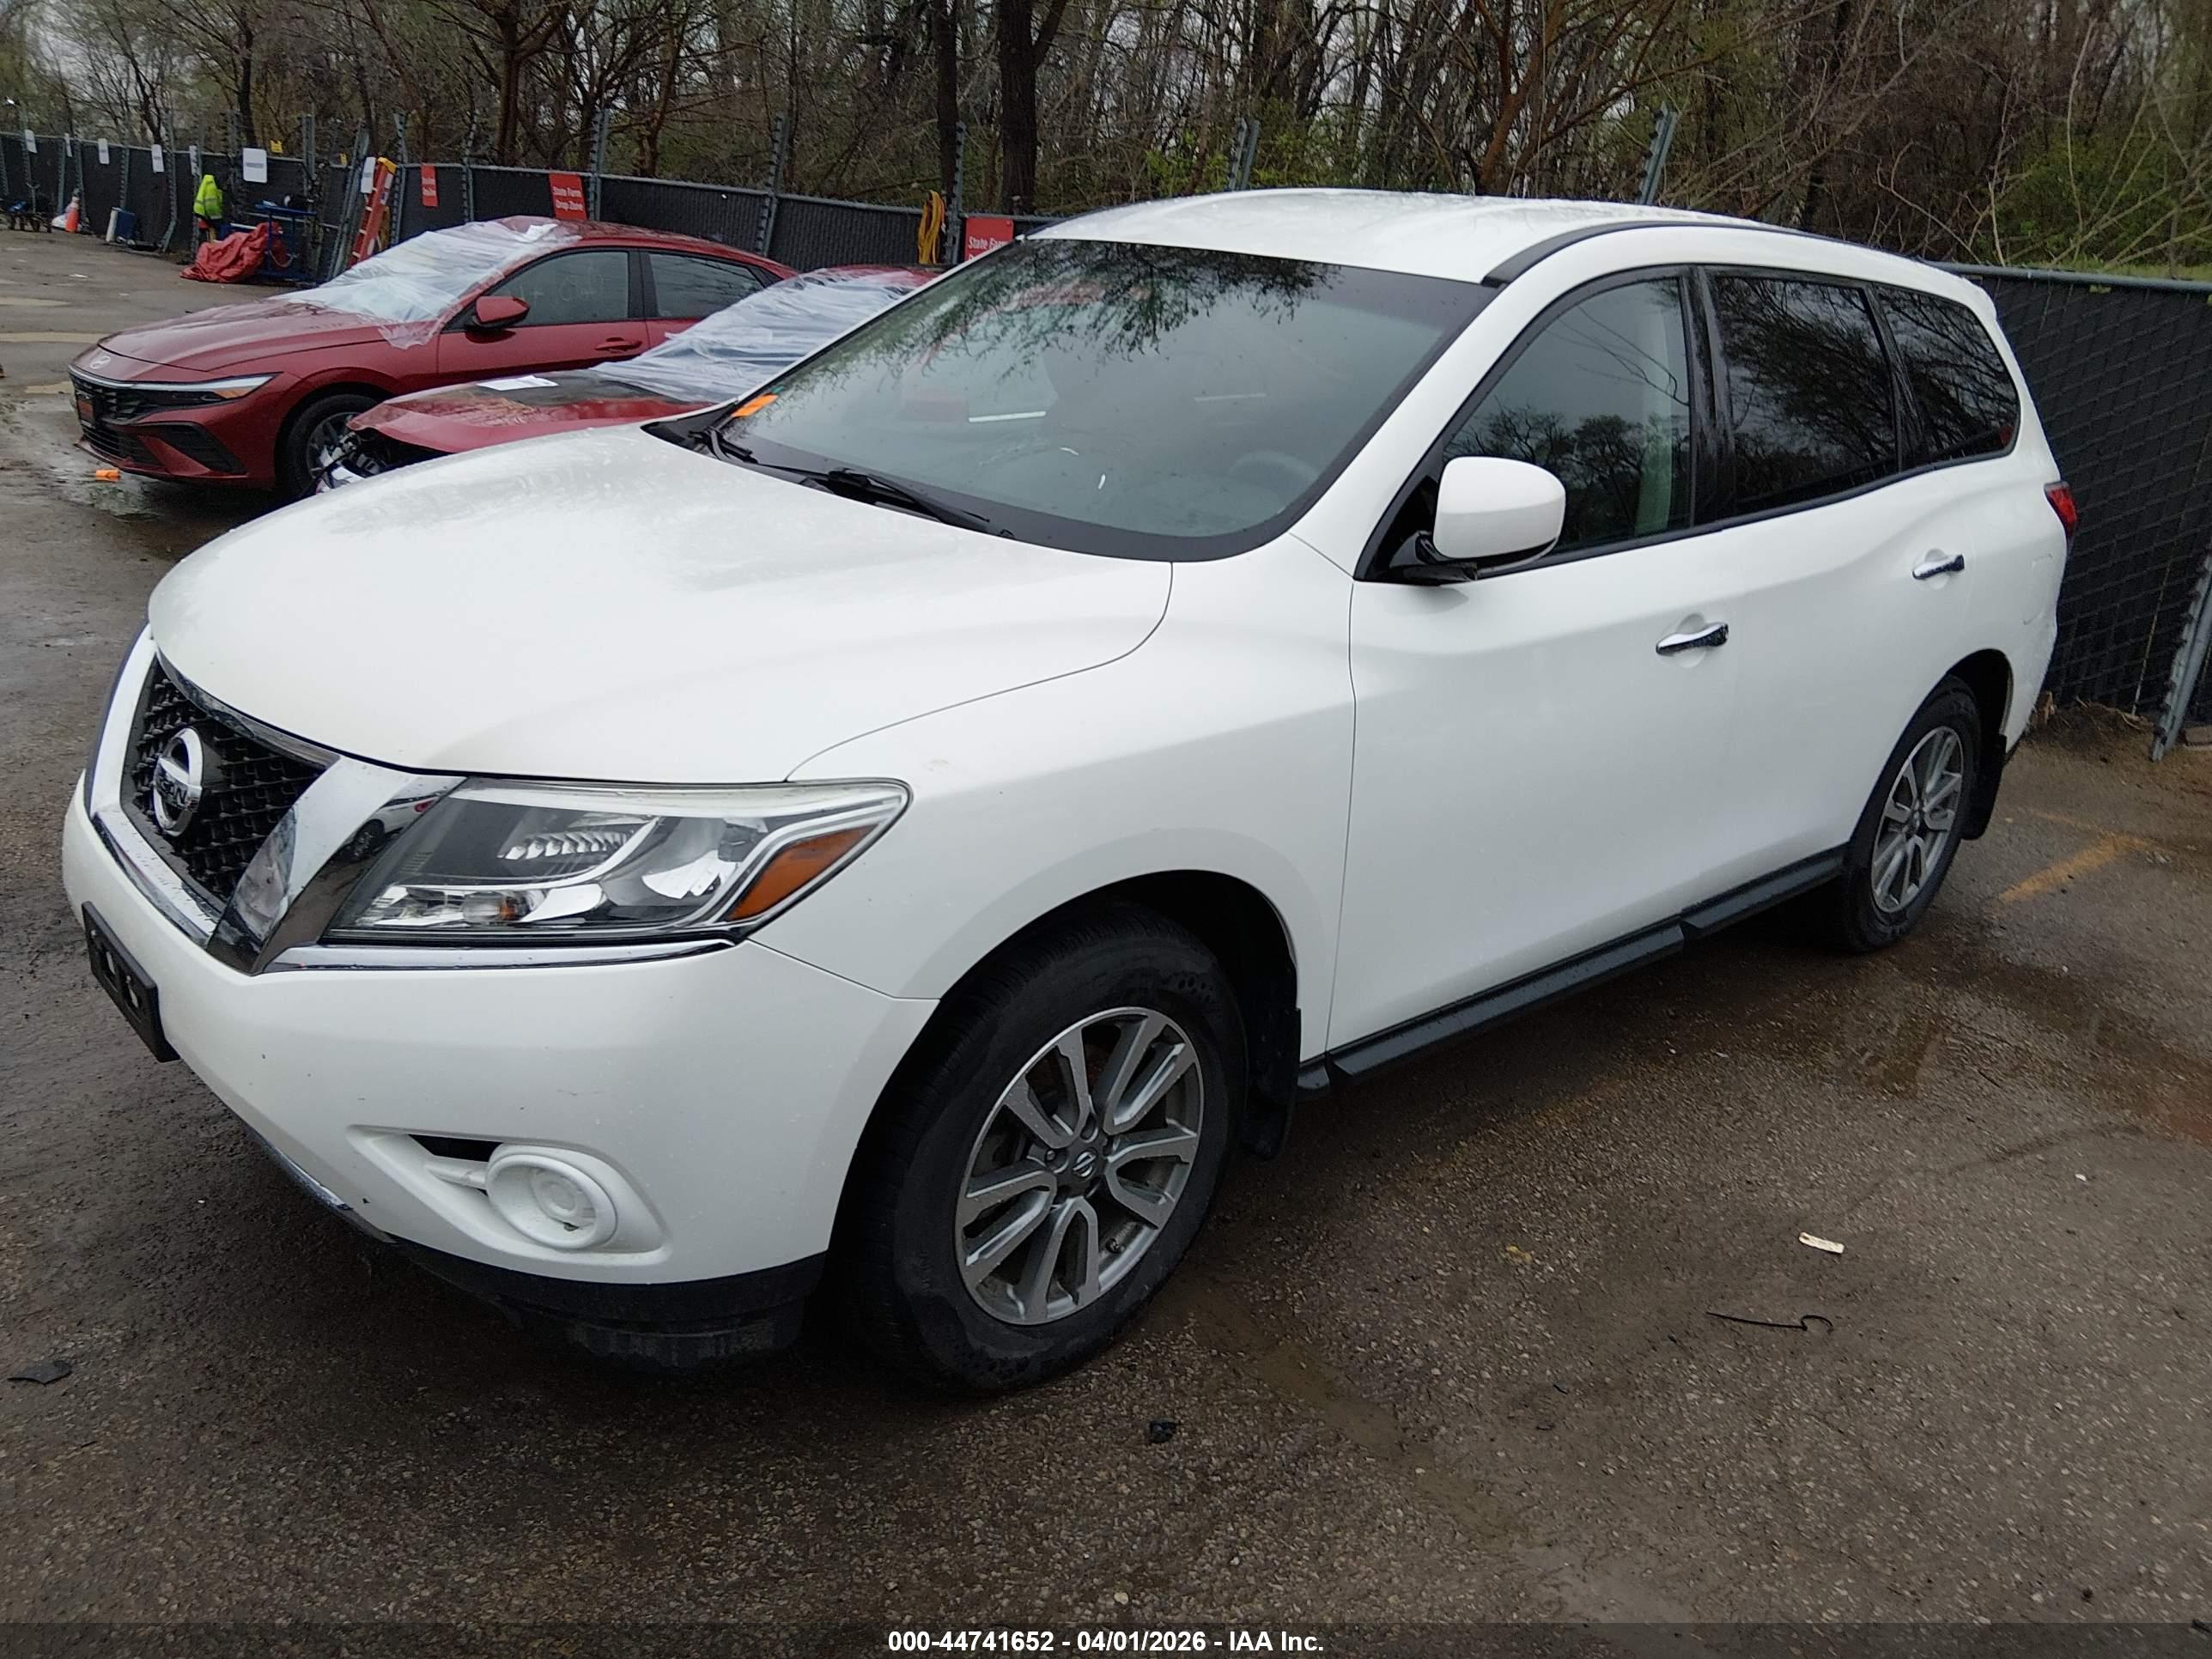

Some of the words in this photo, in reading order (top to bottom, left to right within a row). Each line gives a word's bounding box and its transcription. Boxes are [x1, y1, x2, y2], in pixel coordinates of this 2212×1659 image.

[552, 185, 567, 197] State
[568, 187, 582, 198] Farm
[556, 198, 568, 211] Drop
[969, 236, 988, 249] State
